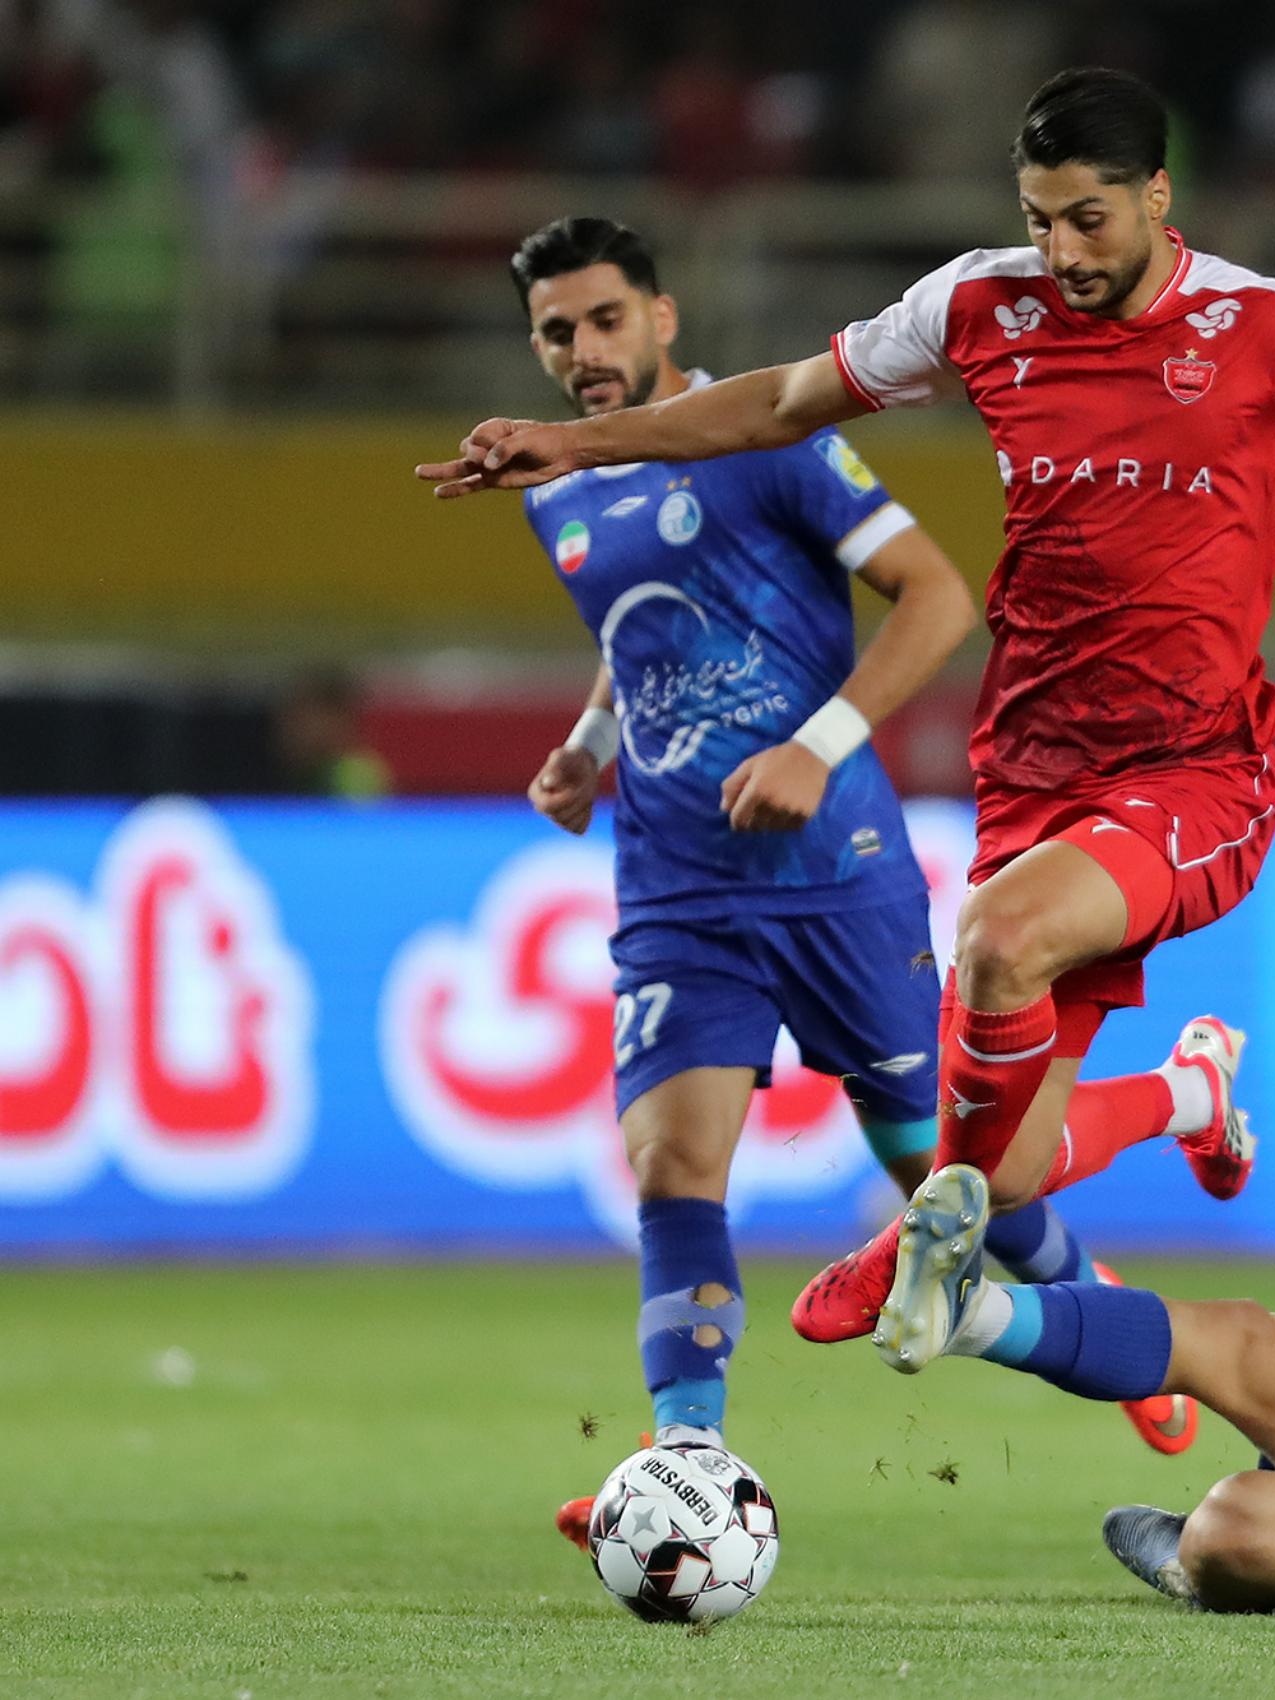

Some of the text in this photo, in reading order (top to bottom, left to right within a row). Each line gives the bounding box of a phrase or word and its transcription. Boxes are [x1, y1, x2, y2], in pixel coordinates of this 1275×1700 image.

[1031, 456, 1212, 494] DARIA
[614, 981, 673, 1069] 27
[640, 1457, 718, 1527] DERBYSTAR
